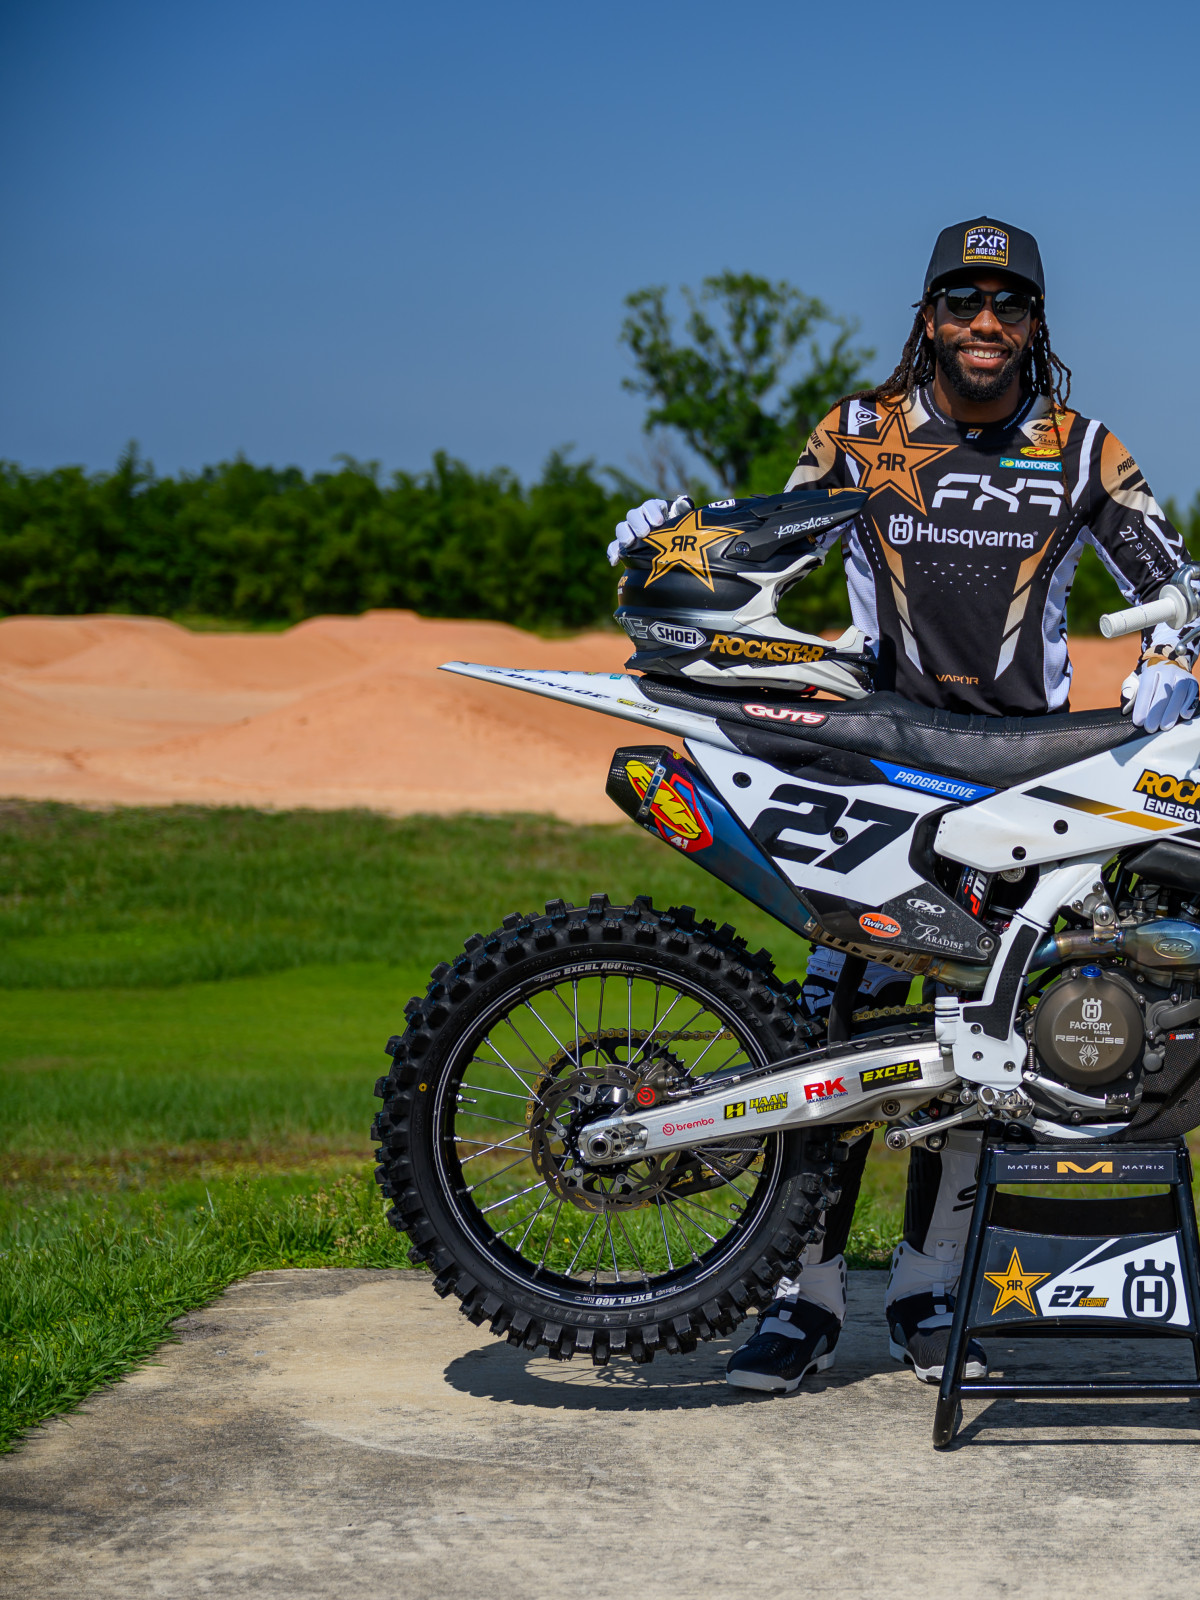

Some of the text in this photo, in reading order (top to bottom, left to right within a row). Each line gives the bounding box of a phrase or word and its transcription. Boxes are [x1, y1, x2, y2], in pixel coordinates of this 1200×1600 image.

[967, 234, 1006, 250] FXR
[975, 247, 989, 255] RIDE
[966, 428, 983, 439] 27
[1015, 460, 1060, 471] MOTOREX
[931, 472, 1065, 517] FXR
[916, 522, 1036, 549] Husqvarna
[658, 626, 698, 645] SHOEI
[709, 633, 824, 663] ROCKSTAR
[503, 672, 611, 699] DUNLOP
[936, 674, 979, 685] VAPOR
[744, 703, 826, 725] GUTS
[893, 770, 977, 800] PROGRESSIVE
[750, 783, 920, 876] 27
[863, 917, 899, 934] Twin Air
[912, 920, 965, 950] PARADISE
[1156, 941, 1194, 955] FMF
[563, 963, 599, 975] EXCEL
[600, 962, 621, 971] A60
[1069, 1021, 1112, 1031] FACTORY
[1055, 1034, 1125, 1045] REKLUSE
[862, 1062, 919, 1083] EXCEL
[803, 1076, 848, 1100] RK
[749, 1092, 789, 1109] HAAN
[756, 1102, 788, 1114] WHEELS
[675, 1117, 715, 1132] brembo
[595, 1296, 617, 1306] A60
[617, 1292, 653, 1304] EXCEL
[1048, 1285, 1095, 1308] 27
[1078, 1297, 1110, 1308] STEWART
